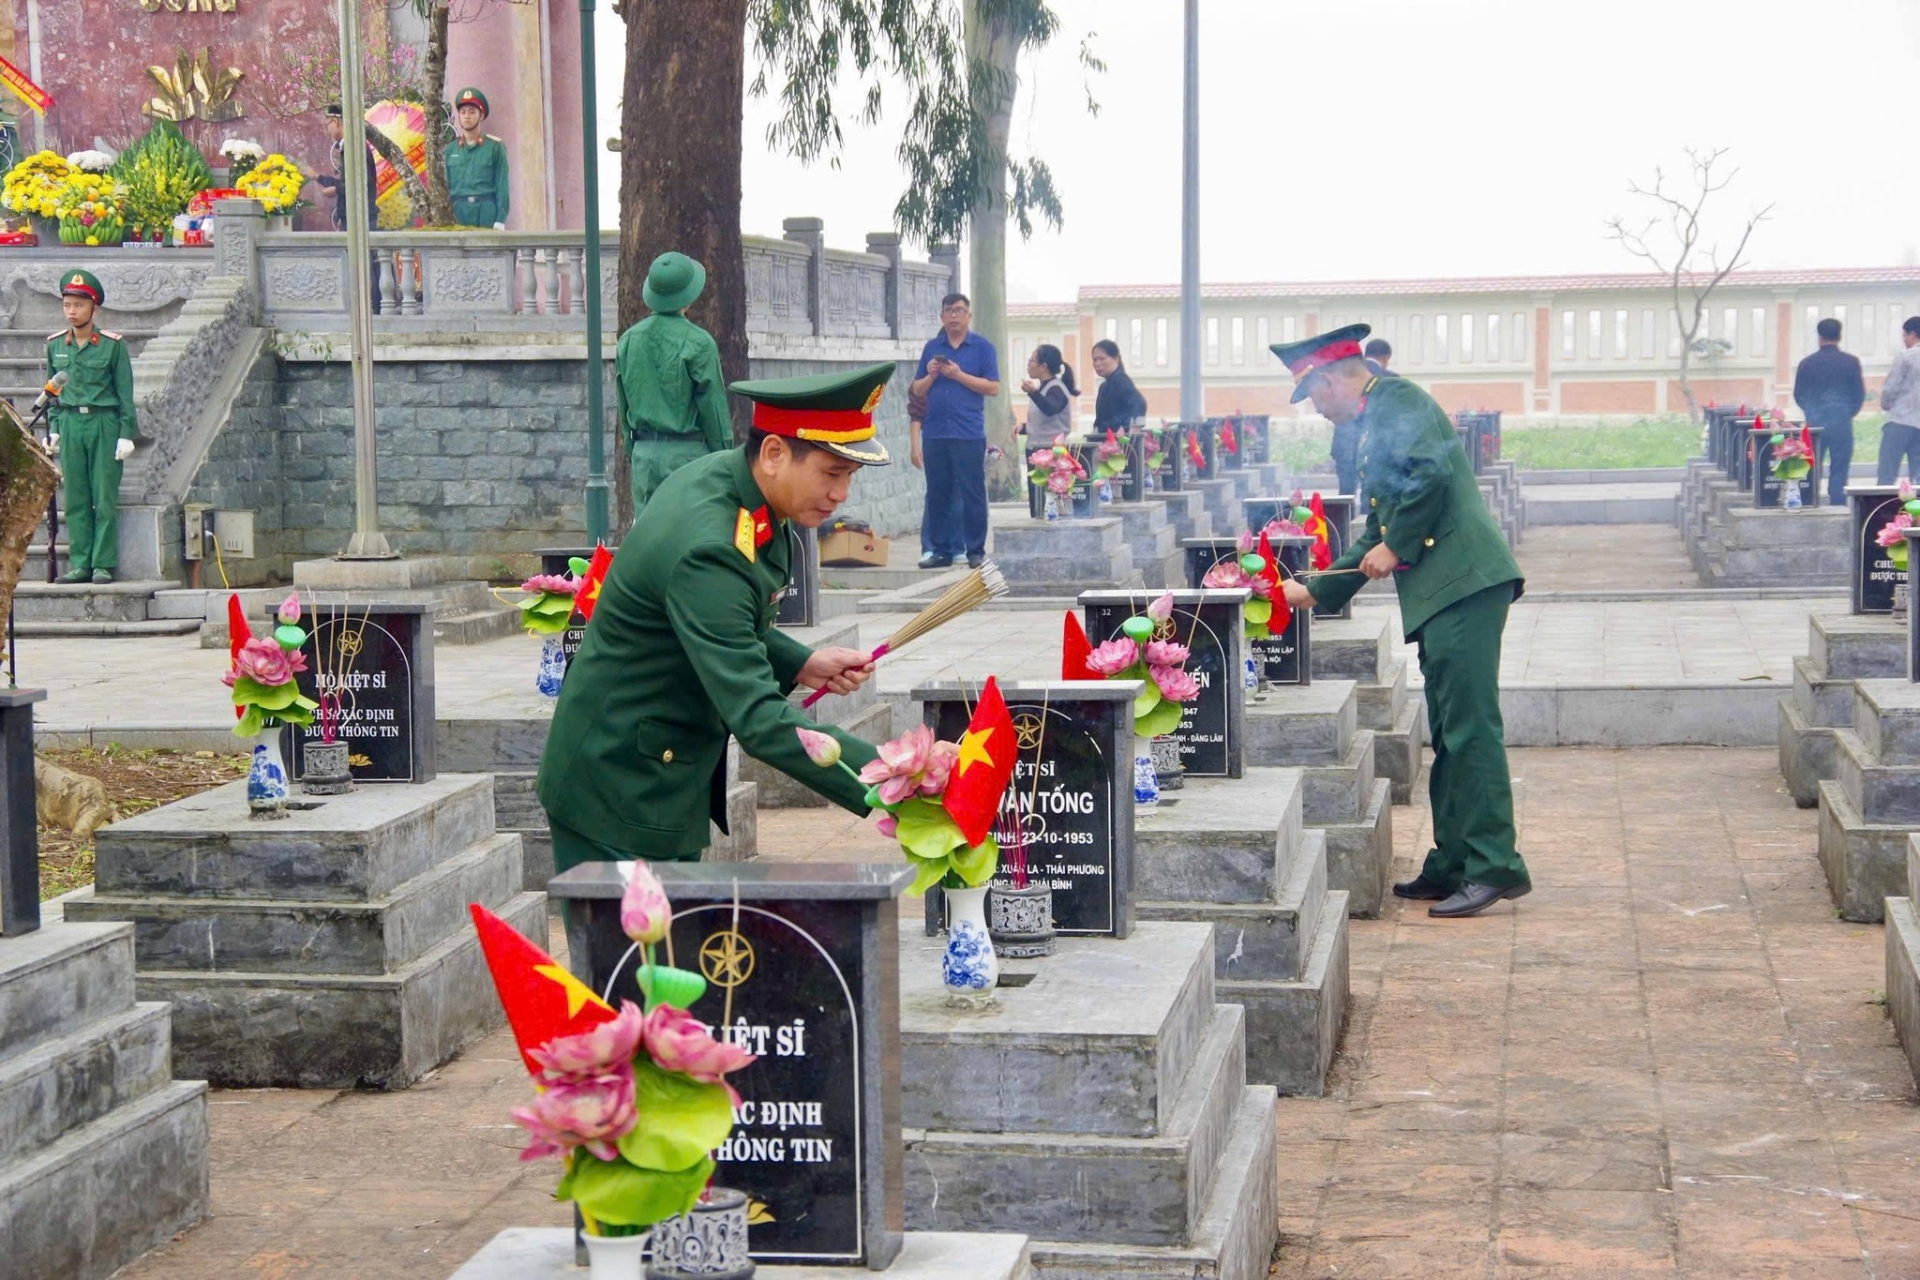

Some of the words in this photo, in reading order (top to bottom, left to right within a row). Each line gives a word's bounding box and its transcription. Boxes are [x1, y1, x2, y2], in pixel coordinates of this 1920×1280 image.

[1101, 608, 1112, 616] 32
[372, 670, 387, 689] SĨ
[365, 708, 395, 724] ĐỊNH
[1183, 707, 1198, 716] 947
[338, 722, 377, 738] THÔNG
[379, 725, 400, 738] TIN
[1039, 760, 1056, 777] SĨ
[1038, 783, 1094, 814] TỐNG
[1021, 831, 1094, 845] 23-10-1953
[1027, 864, 1039, 875] LA
[1045, 861, 1066, 875] THÁI
[1067, 864, 1105, 876] PHƯƠNG
[1051, 877, 1072, 890] BÌNH
[775, 1017, 806, 1057] SĨ
[760, 1101, 823, 1132] ĐỊNH
[708, 1130, 786, 1162] HÔNG
[789, 1137, 833, 1163] TIN
